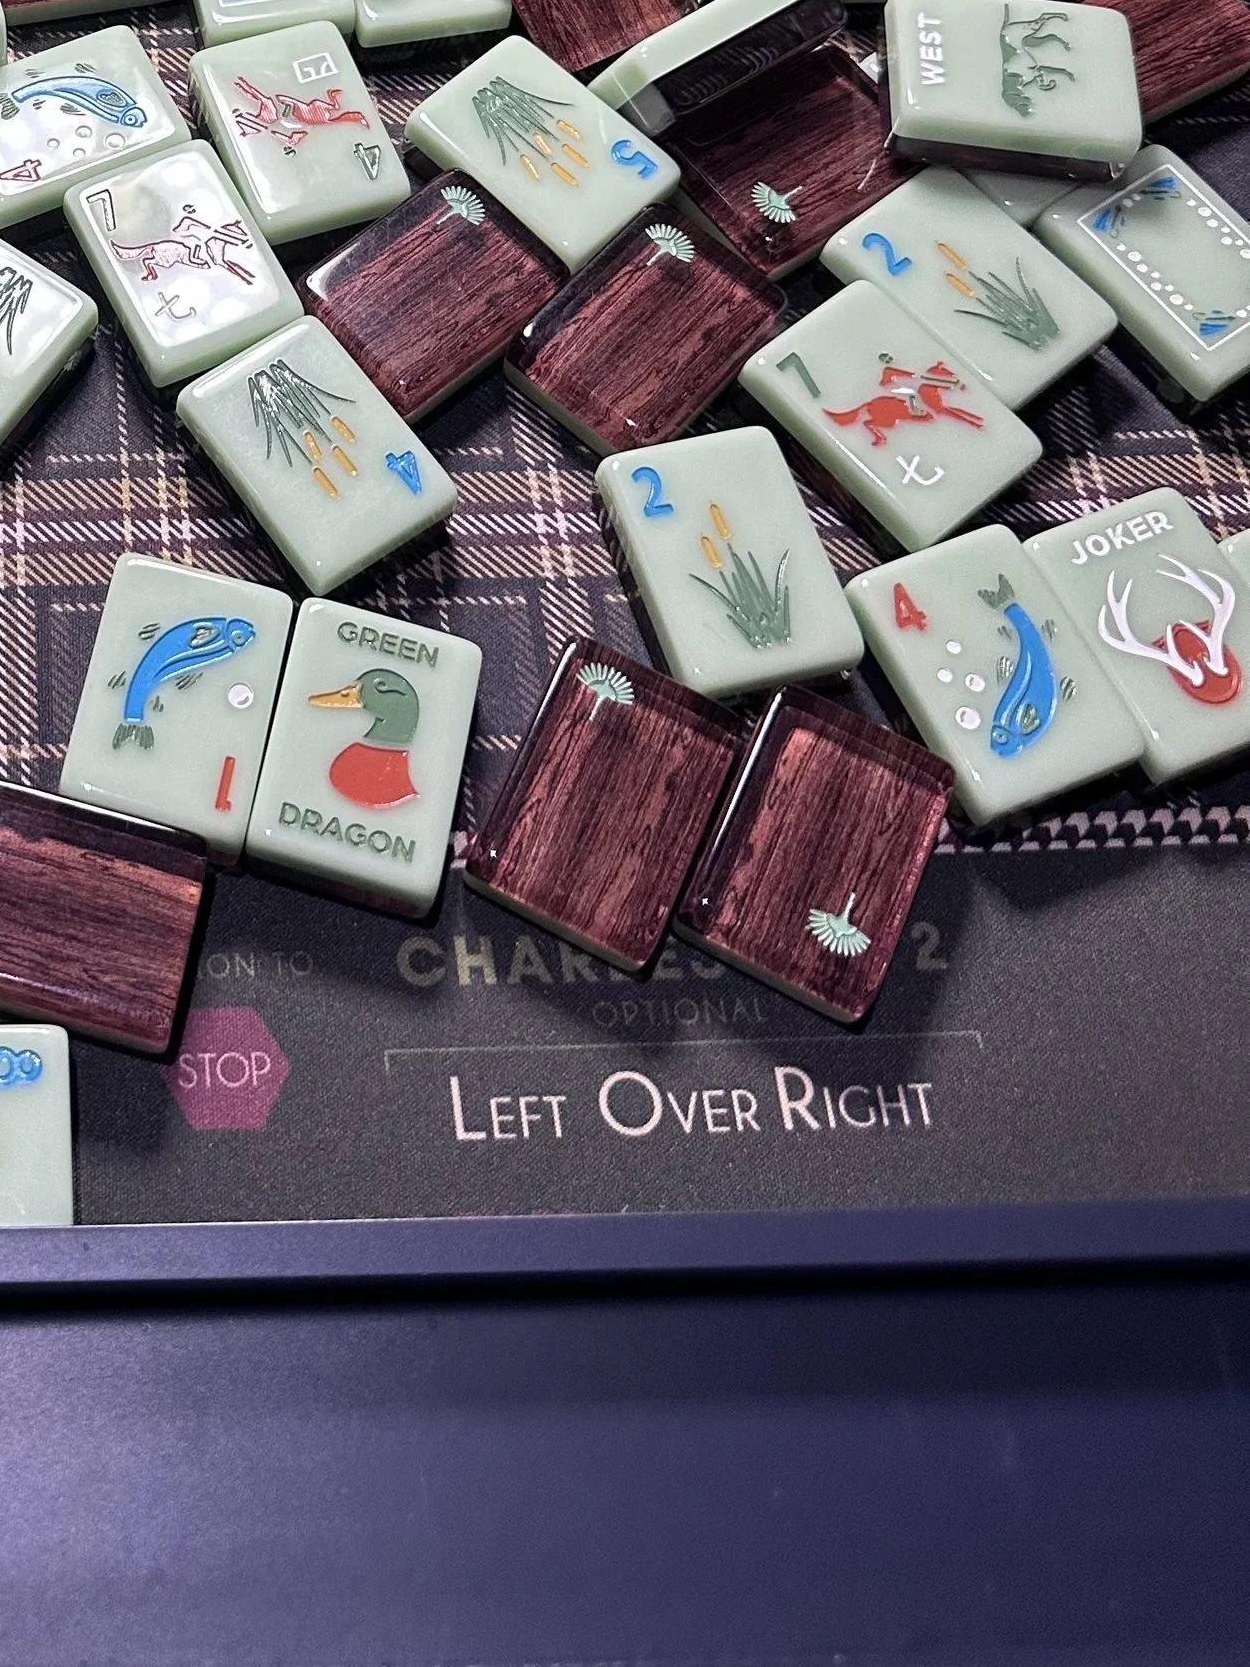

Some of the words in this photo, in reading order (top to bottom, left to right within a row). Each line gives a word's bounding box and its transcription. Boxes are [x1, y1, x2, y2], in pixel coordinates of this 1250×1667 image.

[917, 10, 946, 88] WEST
[352, 141, 383, 181] 4
[610, 138, 661, 182] 5
[85, 188, 118, 233] 7
[861, 231, 913, 277] 2
[153, 290, 199, 322] 七
[776, 351, 822, 399] 7
[384, 448, 422, 496] 4
[630, 465, 675, 519] 2
[895, 452, 945, 488] 七
[1070, 508, 1175, 566] JOKER
[890, 580, 931, 633] 4
[336, 619, 441, 669] GREEN
[215, 754, 237, 812] 1
[278, 802, 419, 864] DRAGON
[912, 922, 951, 972] 2
[591, 998, 769, 1029] OPTIONAL
[179, 1051, 272, 1090] STOP
[449, 1074, 567, 1141] LEFT
[598, 1069, 760, 1137] OVER
[773, 1064, 933, 1132] RIGHT
